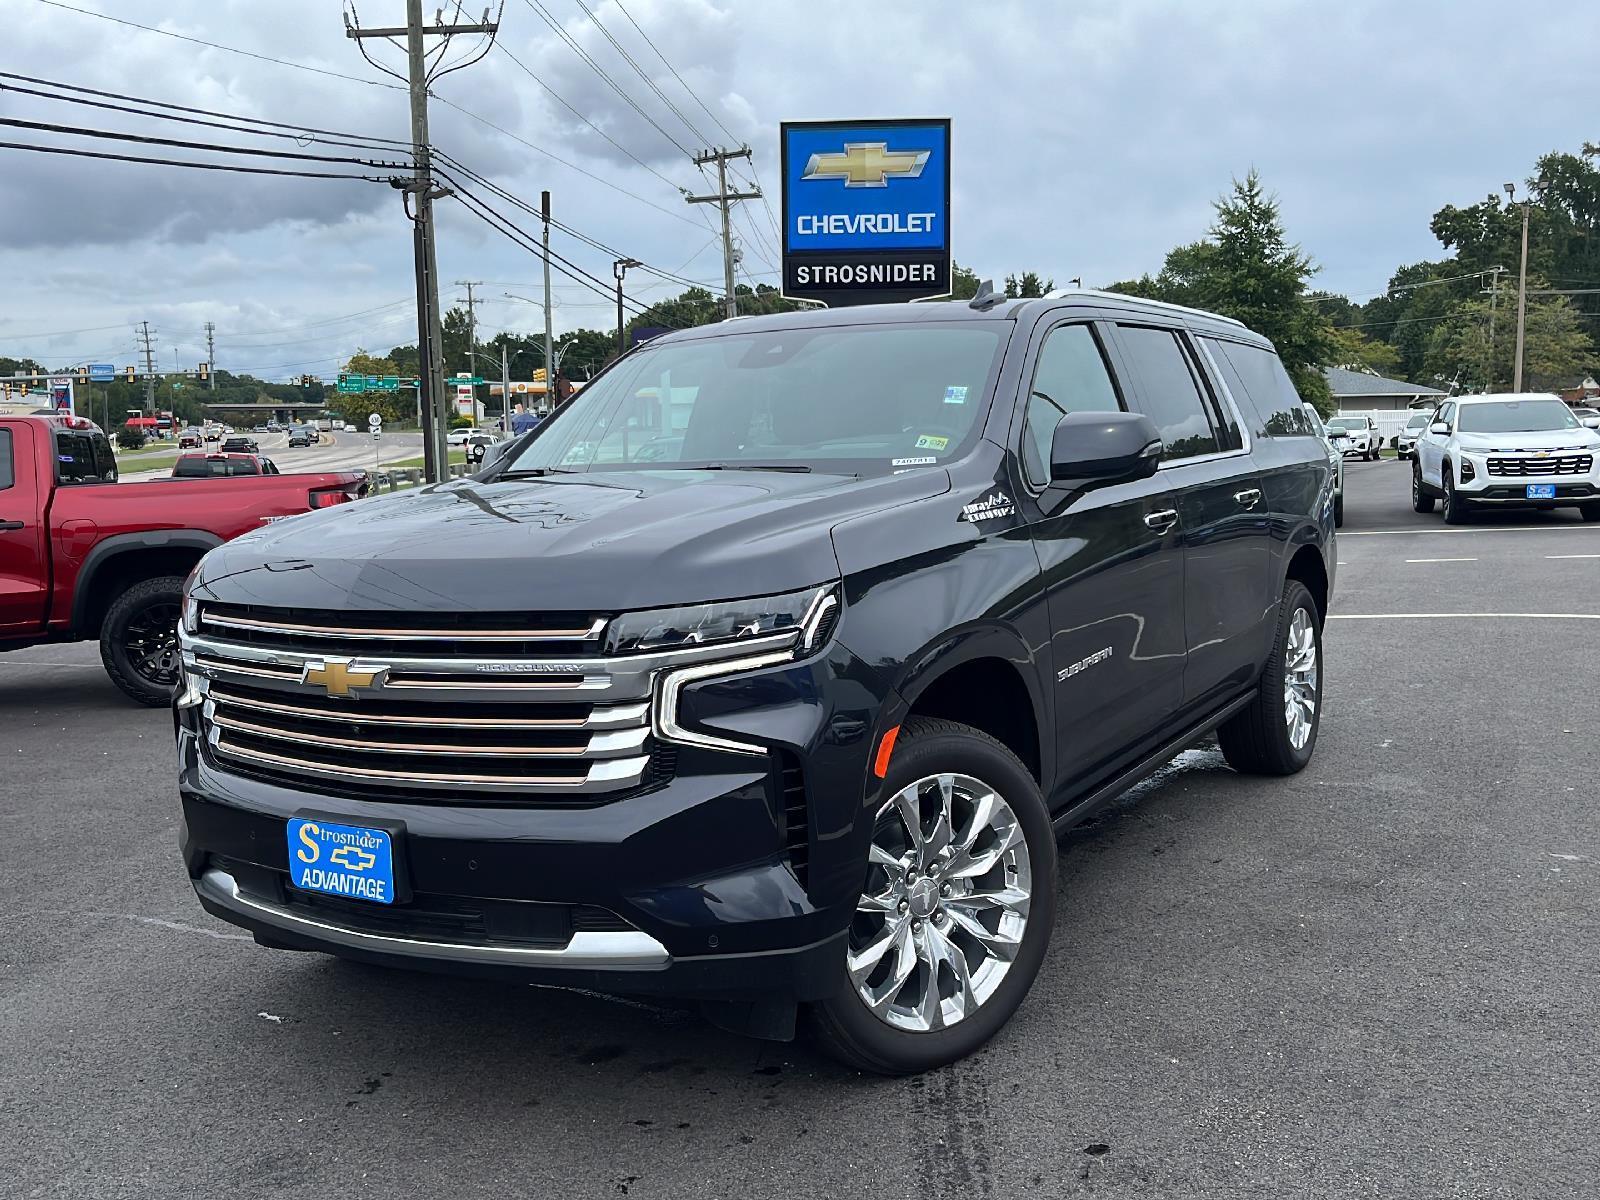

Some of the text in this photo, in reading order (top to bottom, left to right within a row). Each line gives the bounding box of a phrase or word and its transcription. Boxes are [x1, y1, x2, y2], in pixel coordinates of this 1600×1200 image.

[797, 213, 936, 235] CHEVROLET
[797, 264, 936, 284] STROSNIDER
[476, 664, 584, 672] HIGH COUNTRY
[1057, 646, 1113, 682] SUBURBAN
[297, 823, 383, 864] Strosnider
[301, 868, 386, 900] ADVANTAGE
